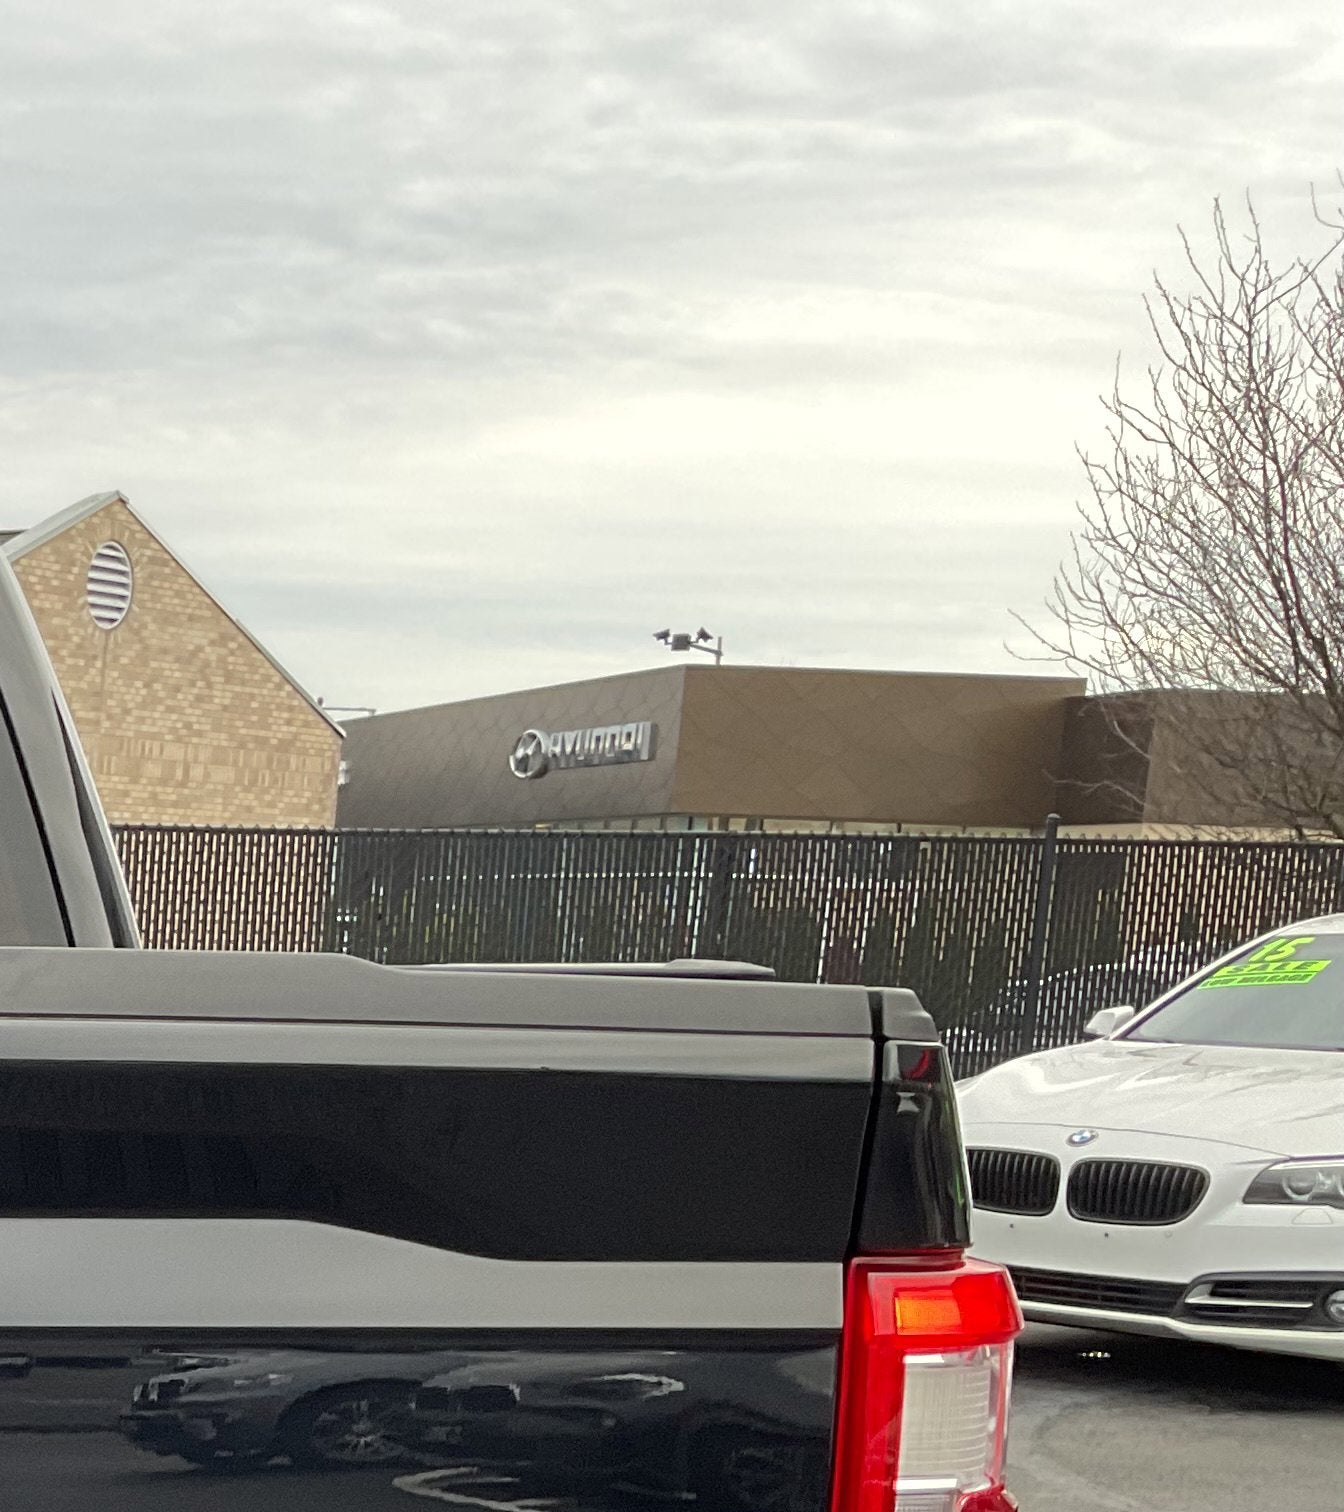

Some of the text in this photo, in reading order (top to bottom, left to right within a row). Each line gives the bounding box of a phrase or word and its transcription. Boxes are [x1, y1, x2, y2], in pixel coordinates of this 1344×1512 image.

[548, 720, 652, 762] HYUNDAI
[1248, 936, 1316, 962] 15
[1227, 962, 1320, 973] SALE
